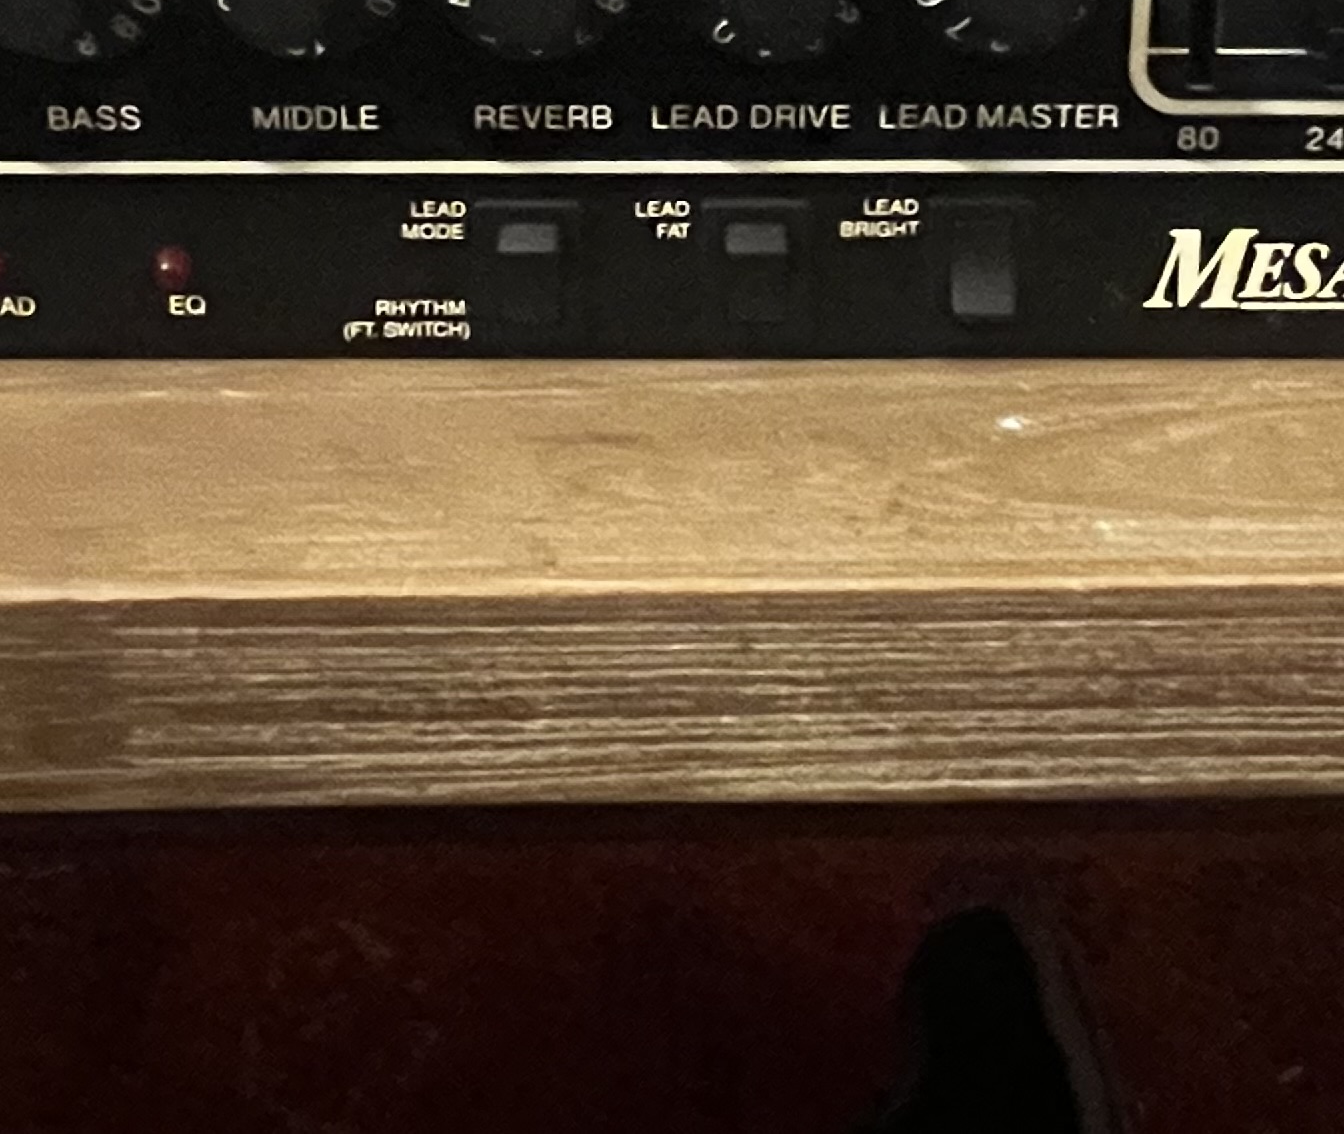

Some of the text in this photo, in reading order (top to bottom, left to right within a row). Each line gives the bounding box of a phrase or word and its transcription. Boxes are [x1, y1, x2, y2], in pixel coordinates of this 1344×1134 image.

[46, 105, 143, 132] BASS
[252, 105, 382, 131] MIDDLE
[473, 105, 614, 131] REVERB
[651, 104, 852, 129] LEAD DRIVE
[879, 104, 1120, 130] LEAD MASTER
[1177, 126, 1220, 151] 80
[410, 201, 467, 217] LEAD
[634, 200, 690, 217] LEAD
[863, 198, 920, 216] LEAD
[401, 223, 465, 239] MODE
[656, 222, 691, 239] FAT
[838, 220, 920, 238] BRIGHT
[168, 295, 206, 315] EQ
[375, 300, 466, 316] RHYTHM
[343, 322, 471, 341] (FT. SWITCH)
